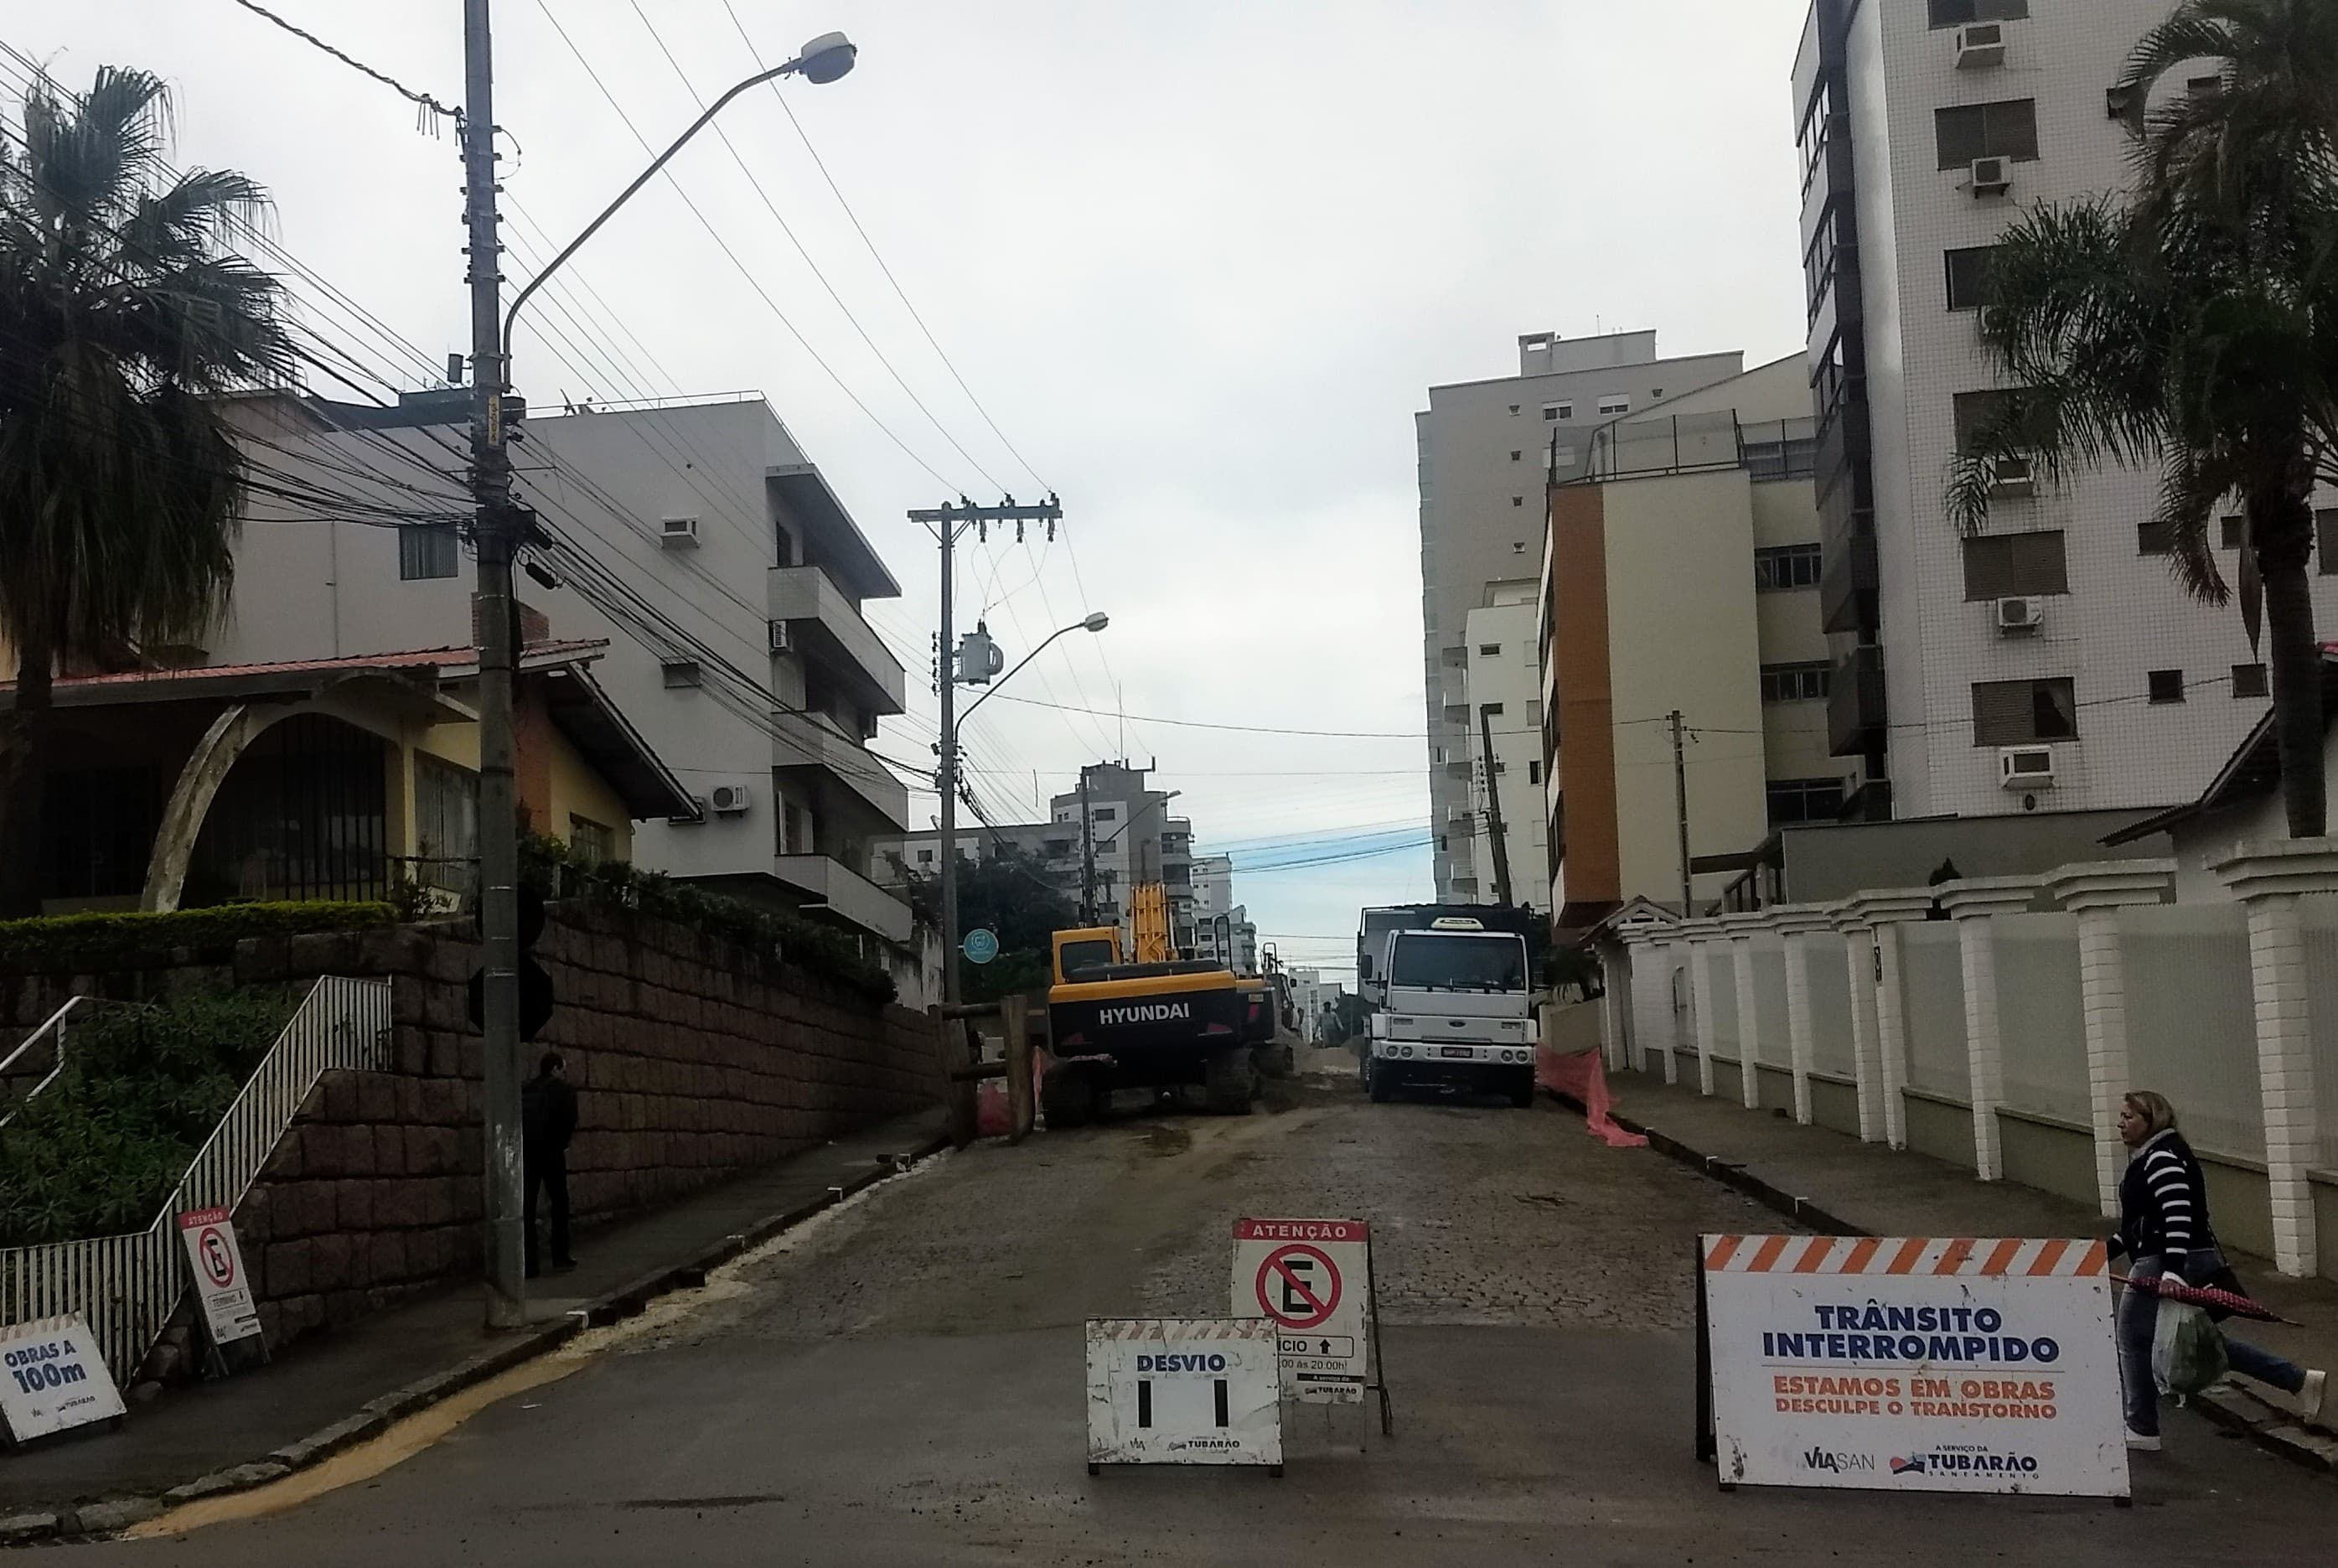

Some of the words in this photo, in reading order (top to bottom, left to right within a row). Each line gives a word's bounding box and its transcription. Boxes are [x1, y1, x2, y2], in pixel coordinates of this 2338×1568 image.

[1099, 1002, 1190, 1025] HYUNDAI
[1253, 1224, 1347, 1240] ATENÇÃO
[1813, 1298, 2002, 1333] TRÂNSITO
[4, 1343, 59, 1368] OBRAS
[63, 1339, 77, 1355] A
[1762, 1333, 2060, 1364] INTERROMPIDO
[1137, 1354, 1226, 1372] DESVIO
[12, 1364, 87, 1395] 100m
[1773, 1375, 1901, 1398] ESTAMOS
[1911, 1379, 1952, 1399] EM
[1961, 1380, 2056, 1401] OBRAS
[1776, 1399, 1880, 1415] DESCULPE
[1887, 1400, 1903, 1415] O
[1911, 1401, 2057, 1420] TRANSTORNO
[1187, 1437, 1240, 1448] TUBARÃO
[1942, 1445, 1975, 1453] SERVIÇO
[1927, 1452, 2038, 1472] TUBARÃO
